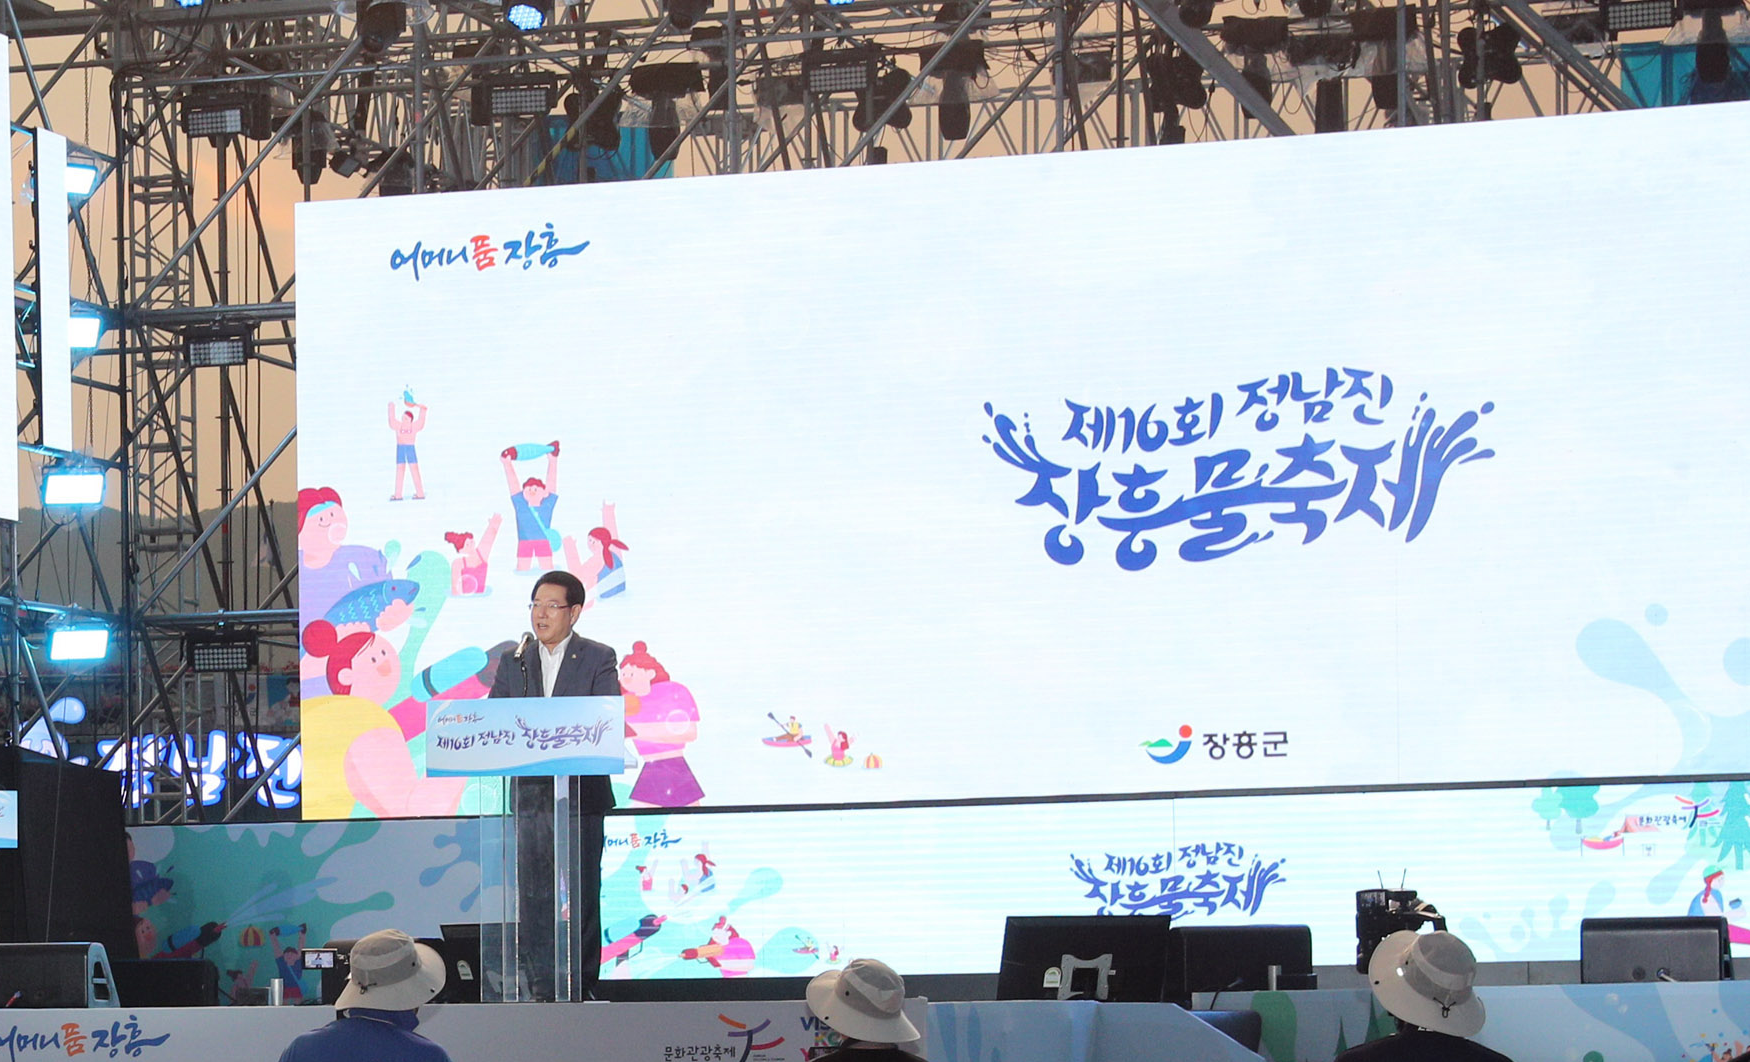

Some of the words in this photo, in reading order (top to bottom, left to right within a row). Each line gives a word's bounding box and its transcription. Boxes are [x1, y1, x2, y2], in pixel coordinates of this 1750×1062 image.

[503, 222, 590, 269] 장흥
[1061, 392, 1224, 453] 제16회
[1236, 366, 1394, 432] 정남진
[436, 735, 475, 751] 제16회
[478, 730, 516, 746] 정남진
[1203, 730, 1289, 760] 장흥군
[644, 829, 682, 849] 장흥
[1104, 851, 1173, 877] 제16회
[1178, 842, 1244, 868] 정남진
[92, 1015, 170, 1057] 장흥
[664, 1044, 736, 1062] 문화관광축제
